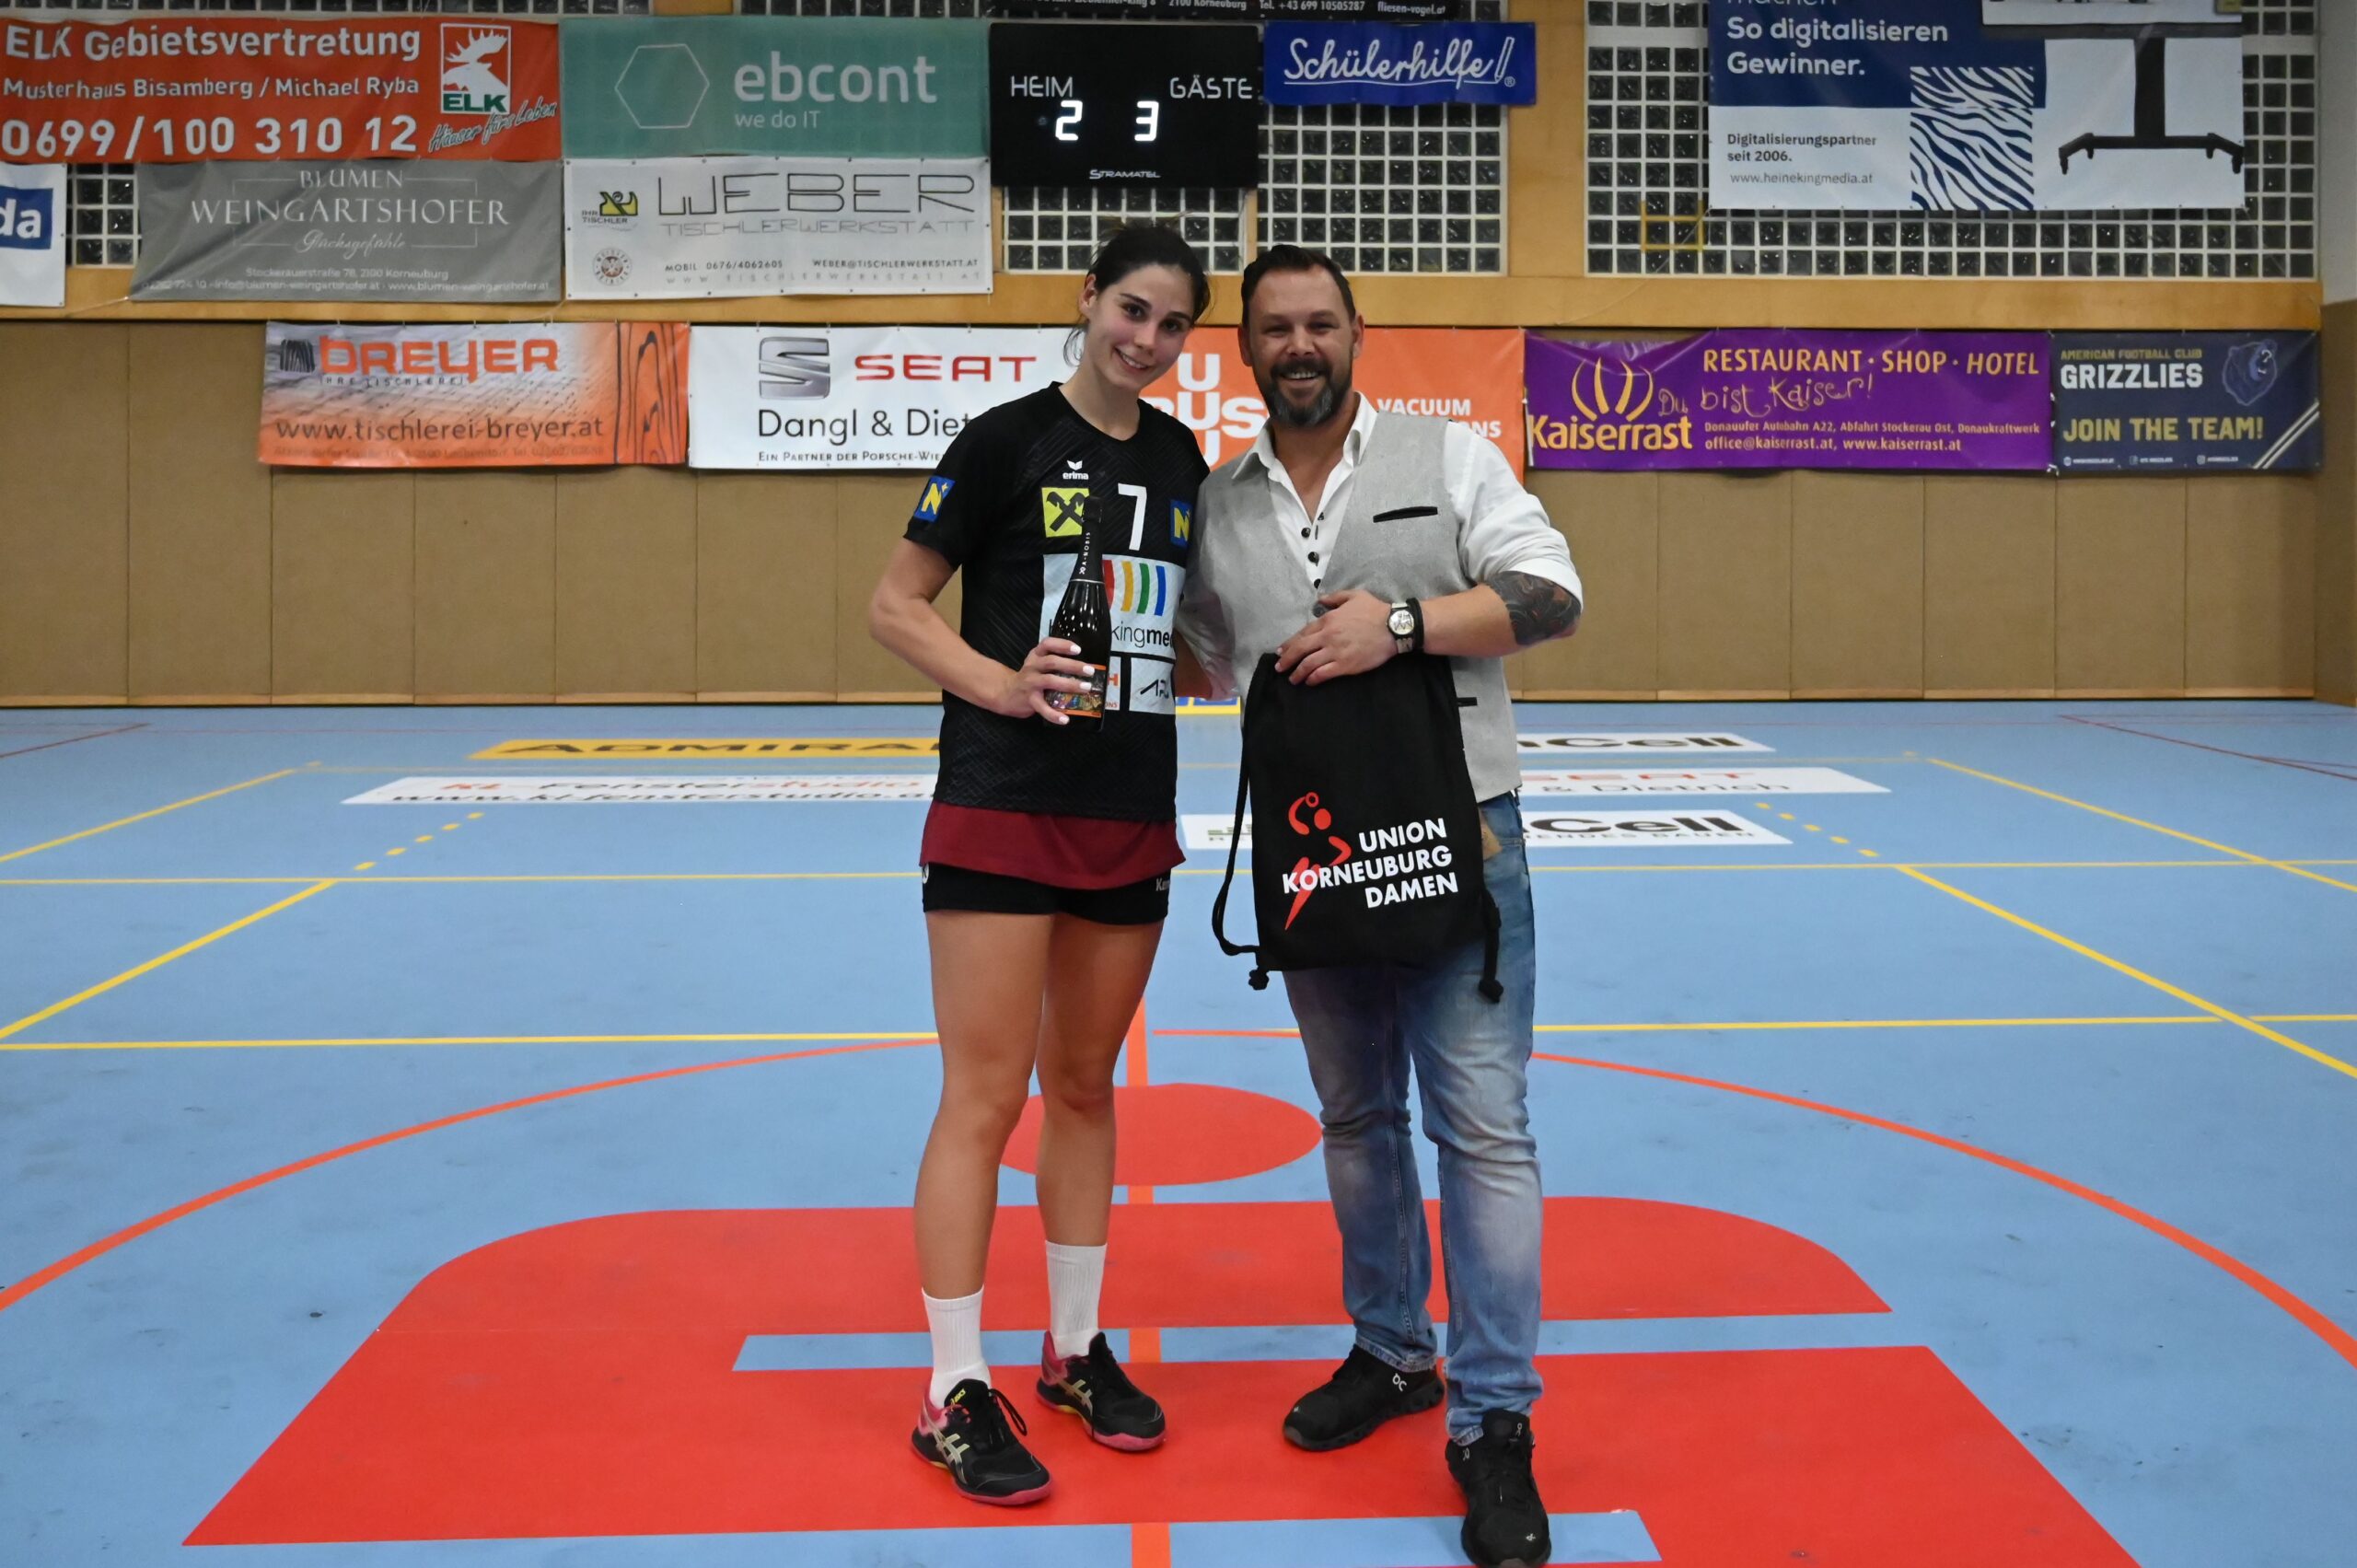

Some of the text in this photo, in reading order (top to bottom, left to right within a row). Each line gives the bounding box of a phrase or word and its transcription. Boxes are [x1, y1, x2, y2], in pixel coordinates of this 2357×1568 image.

[1300, 1, 1318, 10] 699
[6, 25, 420, 61] ELK Gebietsvertretung
[1726, 17, 1948, 47] So digitalisieren
[1726, 52, 1866, 76] Gewinner.
[3, 77, 126, 99] Musterhaus
[134, 77, 253, 99] Bisamberg
[275, 77, 360, 96] Michael
[366, 76, 420, 99] Ryba
[735, 51, 938, 103] ebcont
[1010, 75, 1253, 99] HEIM GÄSTE
[442, 93, 507, 112] ELK
[736, 110, 821, 129] we do IT
[1055, 99, 1159, 141] 2 3
[2, 114, 417, 160] 0699/100 310 12
[1726, 134, 1877, 148] Digitalisierungspartner
[1726, 150, 1793, 162] seit 2006.
[300, 169, 403, 189] BLUMEN
[1089, 168, 1161, 180] STRAMATEL
[1730, 171, 1874, 186] www.heinekingmedia.at
[657, 173, 976, 215] WEBER
[191, 199, 509, 226] WEINGARTSHOFER
[660, 219, 977, 238] TISCHLERWERKSTATT
[385, 268, 449, 281] Korneuburg
[665, 263, 697, 273] MOBIL
[1703, 349, 2040, 375] RESTAURANT SHOP HOTEL
[2061, 348, 2203, 361] AMERICAN FOOTBALL CLUB
[854, 354, 1037, 383] SEAT
[2060, 363, 2203, 389] GRIZZLIES
[1376, 398, 1472, 416] VACUUM
[1658, 388, 1689, 416] Du
[1700, 381, 1773, 418] bist
[275, 416, 604, 443] www.tischlerei-breyer.at
[758, 408, 858, 447] Dangl
[870, 411, 893, 437] &
[1528, 413, 1692, 452] Kaiserrast
[1704, 421, 2041, 435] Donauufer Autobahn A22, Abfahrt Stockerau Ost, Donaukraftwerk
[2062, 416, 2264, 442] JOIN THE TEAM!
[1704, 436, 1961, 451] office@kaiserrast.at, www.kaiserrast.at
[758, 451, 778, 462] EIN
[783, 451, 833, 462] PARTNER
[862, 450, 942, 462] PORSCHE-WIE
[1062, 470, 1089, 481] erima
[1117, 482, 1147, 551] 7
[500, 743, 940, 754] ADMIRA
[1590, 783, 1791, 793] Dietrich
[1358, 817, 1448, 853] UNION
[1524, 816, 1744, 832] Cell
[1282, 844, 1453, 894] KORNEUBURG
[1364, 871, 1459, 909] DAMEN
